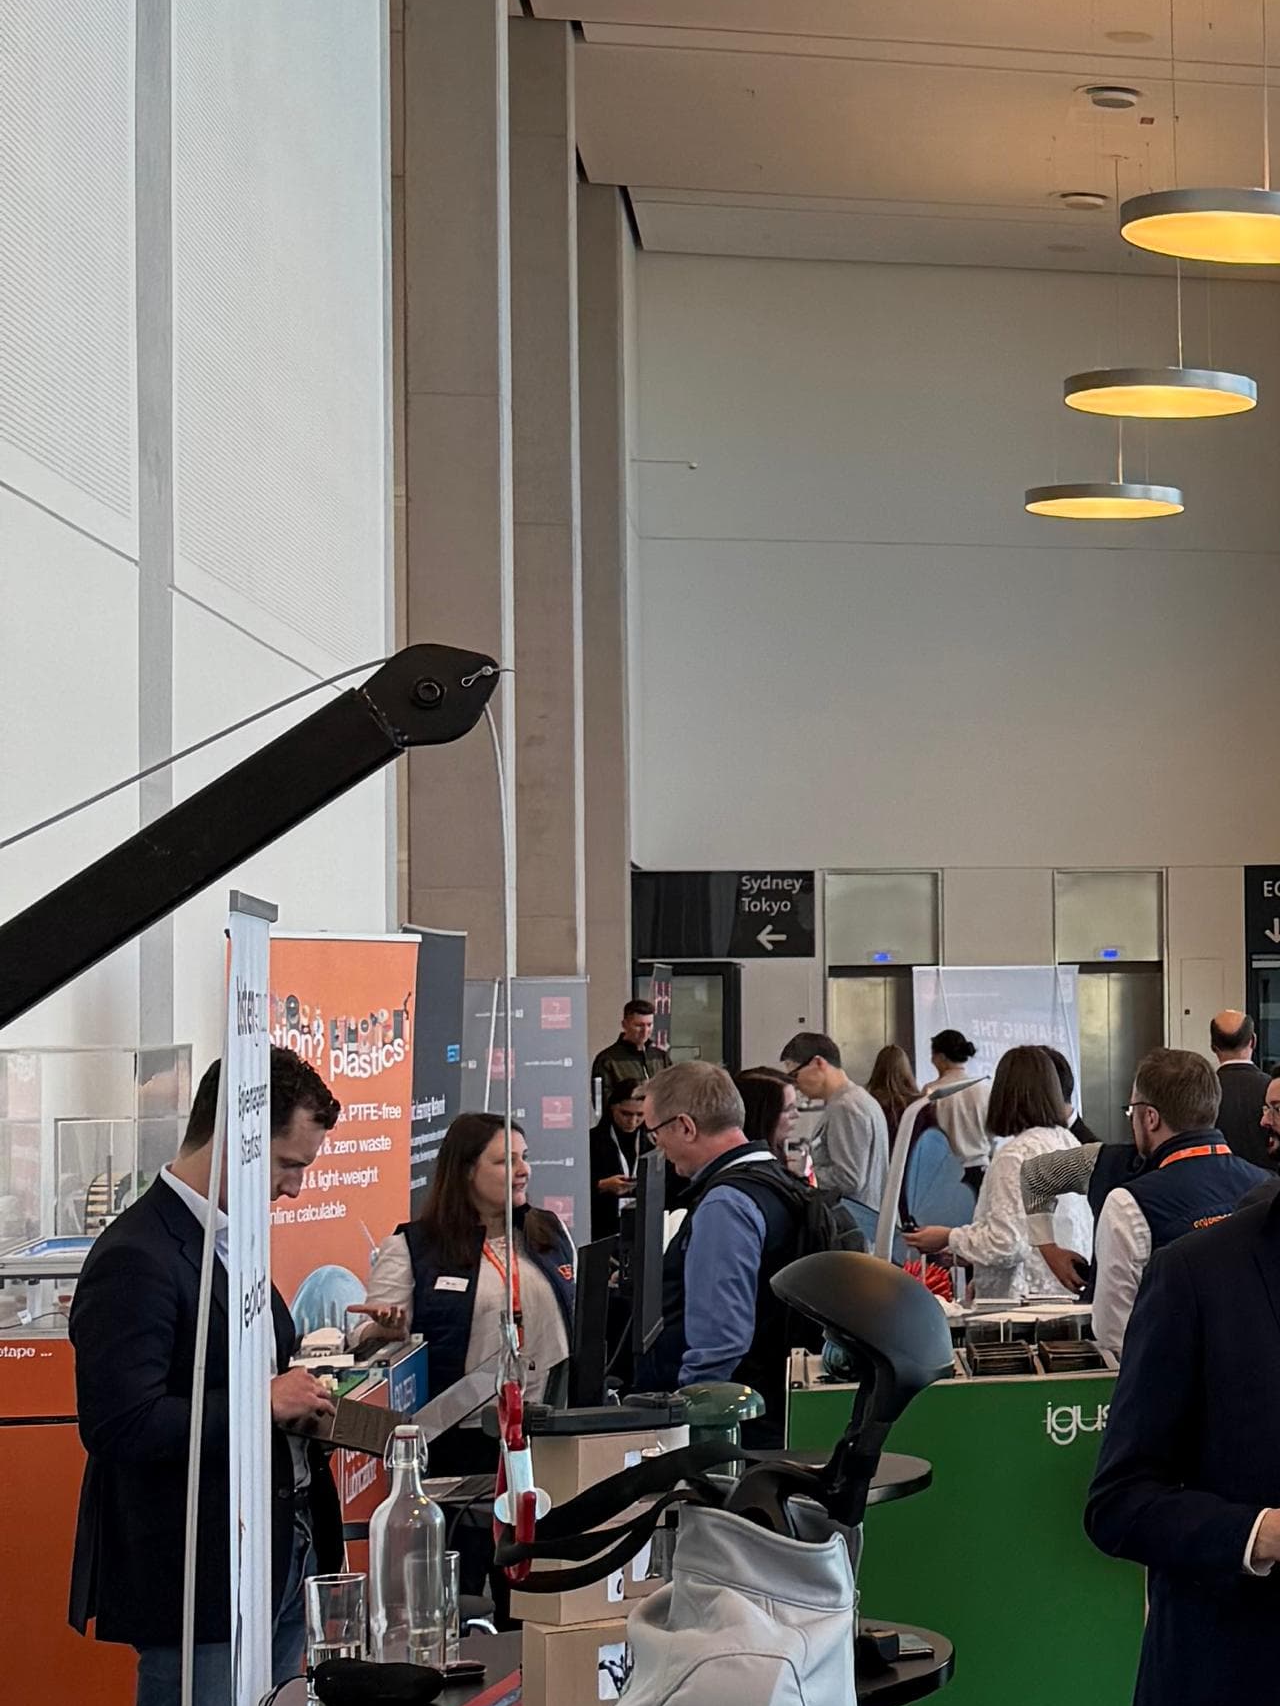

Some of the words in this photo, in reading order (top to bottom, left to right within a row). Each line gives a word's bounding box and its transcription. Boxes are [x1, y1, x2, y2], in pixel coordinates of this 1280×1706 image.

[741, 875, 803, 894] Sydney
[741, 897, 791, 916] Tokyo
[347, 1103, 402, 1121] PTFE-free
[334, 1141, 357, 1155] zero
[359, 1134, 392, 1151] waste
[317, 1167, 379, 1192] light-weight
[296, 1199, 346, 1221] calculable
